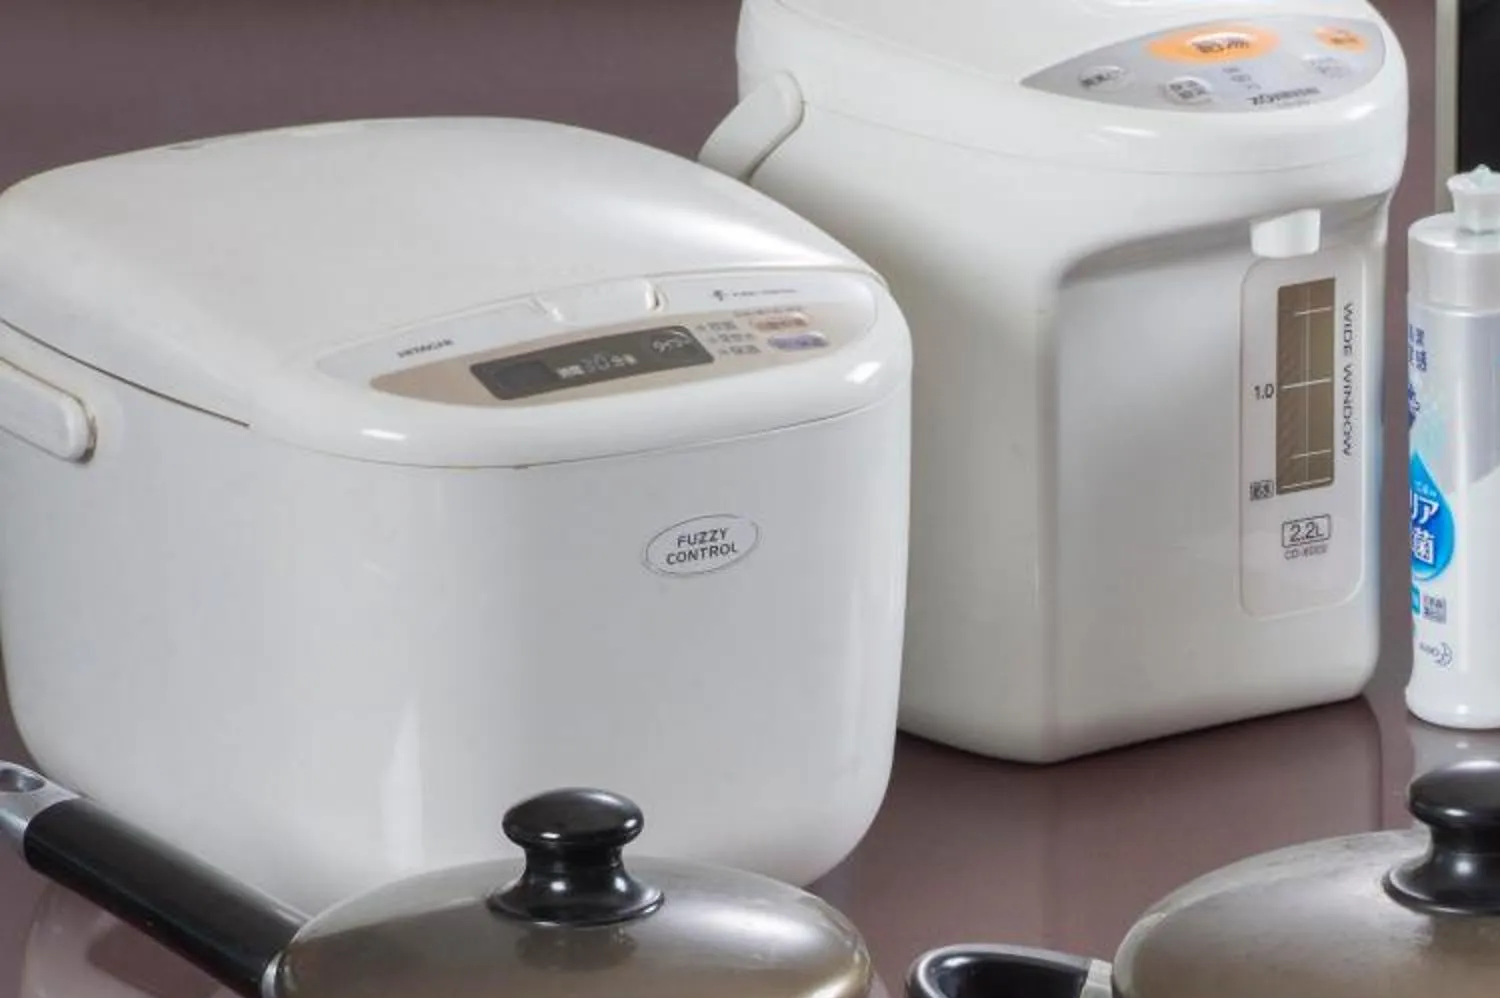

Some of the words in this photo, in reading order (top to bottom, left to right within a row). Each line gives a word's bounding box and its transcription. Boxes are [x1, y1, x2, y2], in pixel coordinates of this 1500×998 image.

[1343, 303, 1354, 357] WIDE
[1254, 384, 1275, 400] 1.0
[1343, 363, 1353, 457] WINDOW
[677, 526, 729, 548] FUZZY
[1289, 520, 1325, 542] 2.2L
[666, 541, 739, 566] CONTROL
